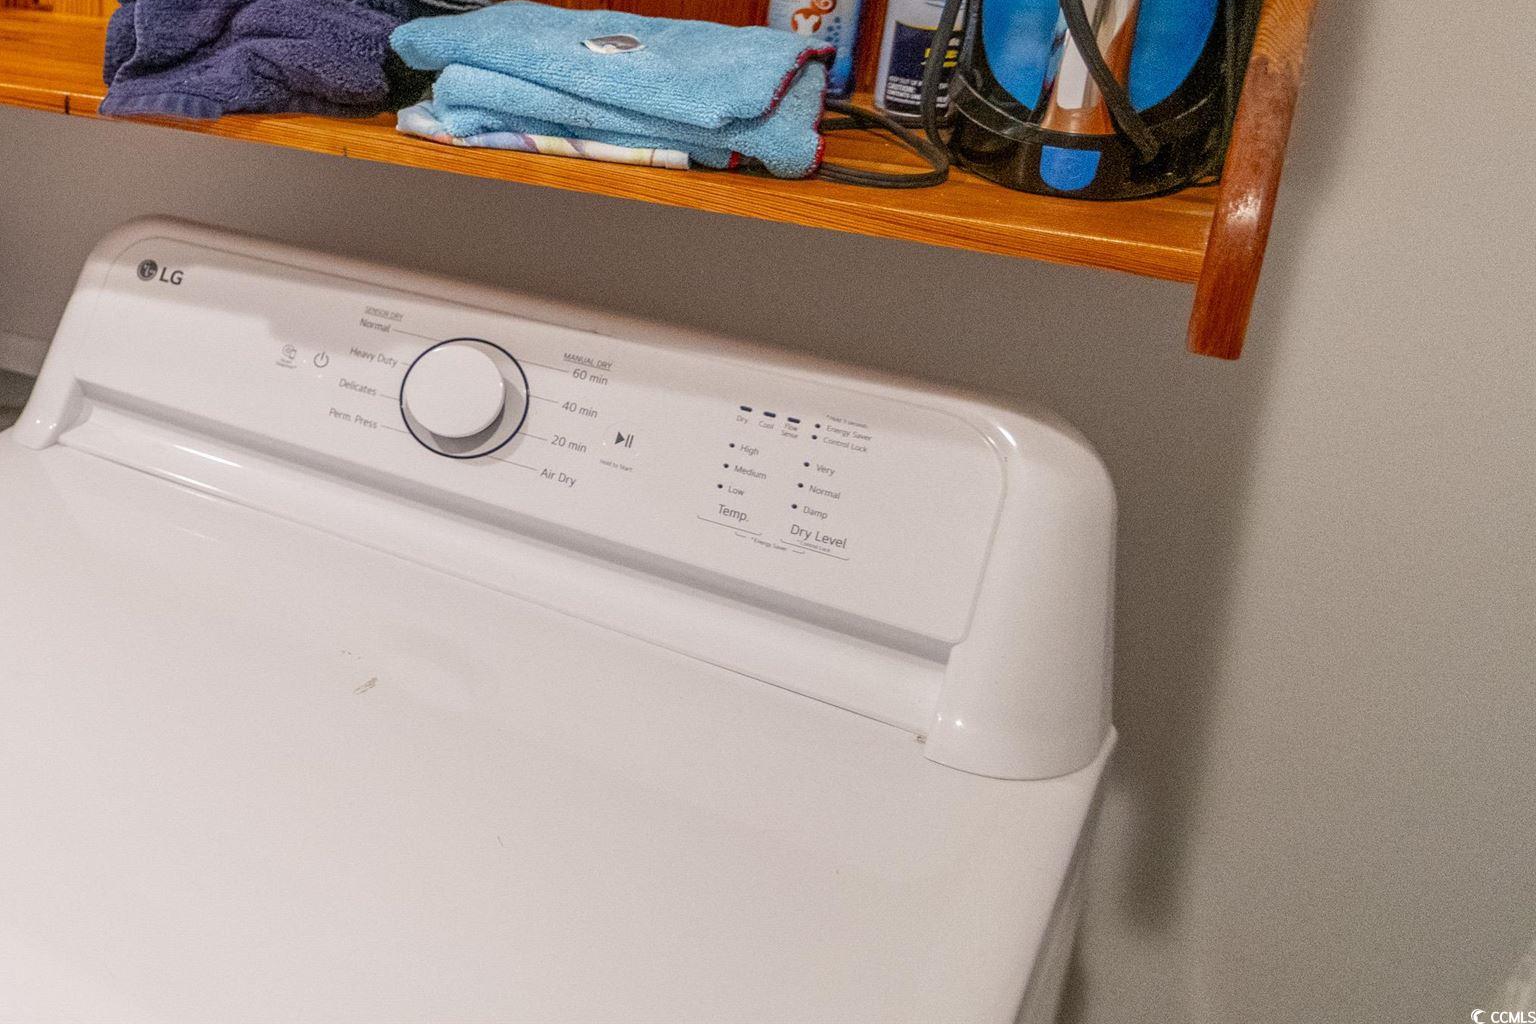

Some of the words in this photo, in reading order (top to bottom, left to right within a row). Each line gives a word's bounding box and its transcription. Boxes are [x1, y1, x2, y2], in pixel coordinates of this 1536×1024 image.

[159, 267, 184, 285] LG
[360, 318, 391, 333] Normal
[350, 346, 375, 363] Heavy
[377, 353, 398, 368] Duty
[564, 352, 594, 366] MANUAL
[597, 359, 613, 370] DRY
[572, 367, 587, 381] 60
[589, 373, 608, 385] min
[338, 378, 377, 396] Delicates
[562, 401, 577, 413] 40
[578, 406, 598, 418] min
[354, 414, 378, 429] Press
[736, 414, 748, 425] Dry
[826, 425, 851, 437] Energy
[852, 431, 872, 442] Saver
[551, 434, 566, 447] 20
[568, 440, 587, 453] min
[740, 443, 759, 456] High
[823, 437, 850, 449] Control
[851, 443, 867, 453] Lock
[540, 468, 555, 480] Air
[558, 472, 577, 488] Dry
[734, 464, 767, 480] Medium
[816, 463, 835, 477] Very
[727, 485, 744, 496] Low
[809, 484, 841, 500] Normal
[718, 503, 749, 522] Temp.
[803, 505, 828, 520] Damp
[790, 523, 812, 541] Dry
[814, 531, 847, 549] Level
